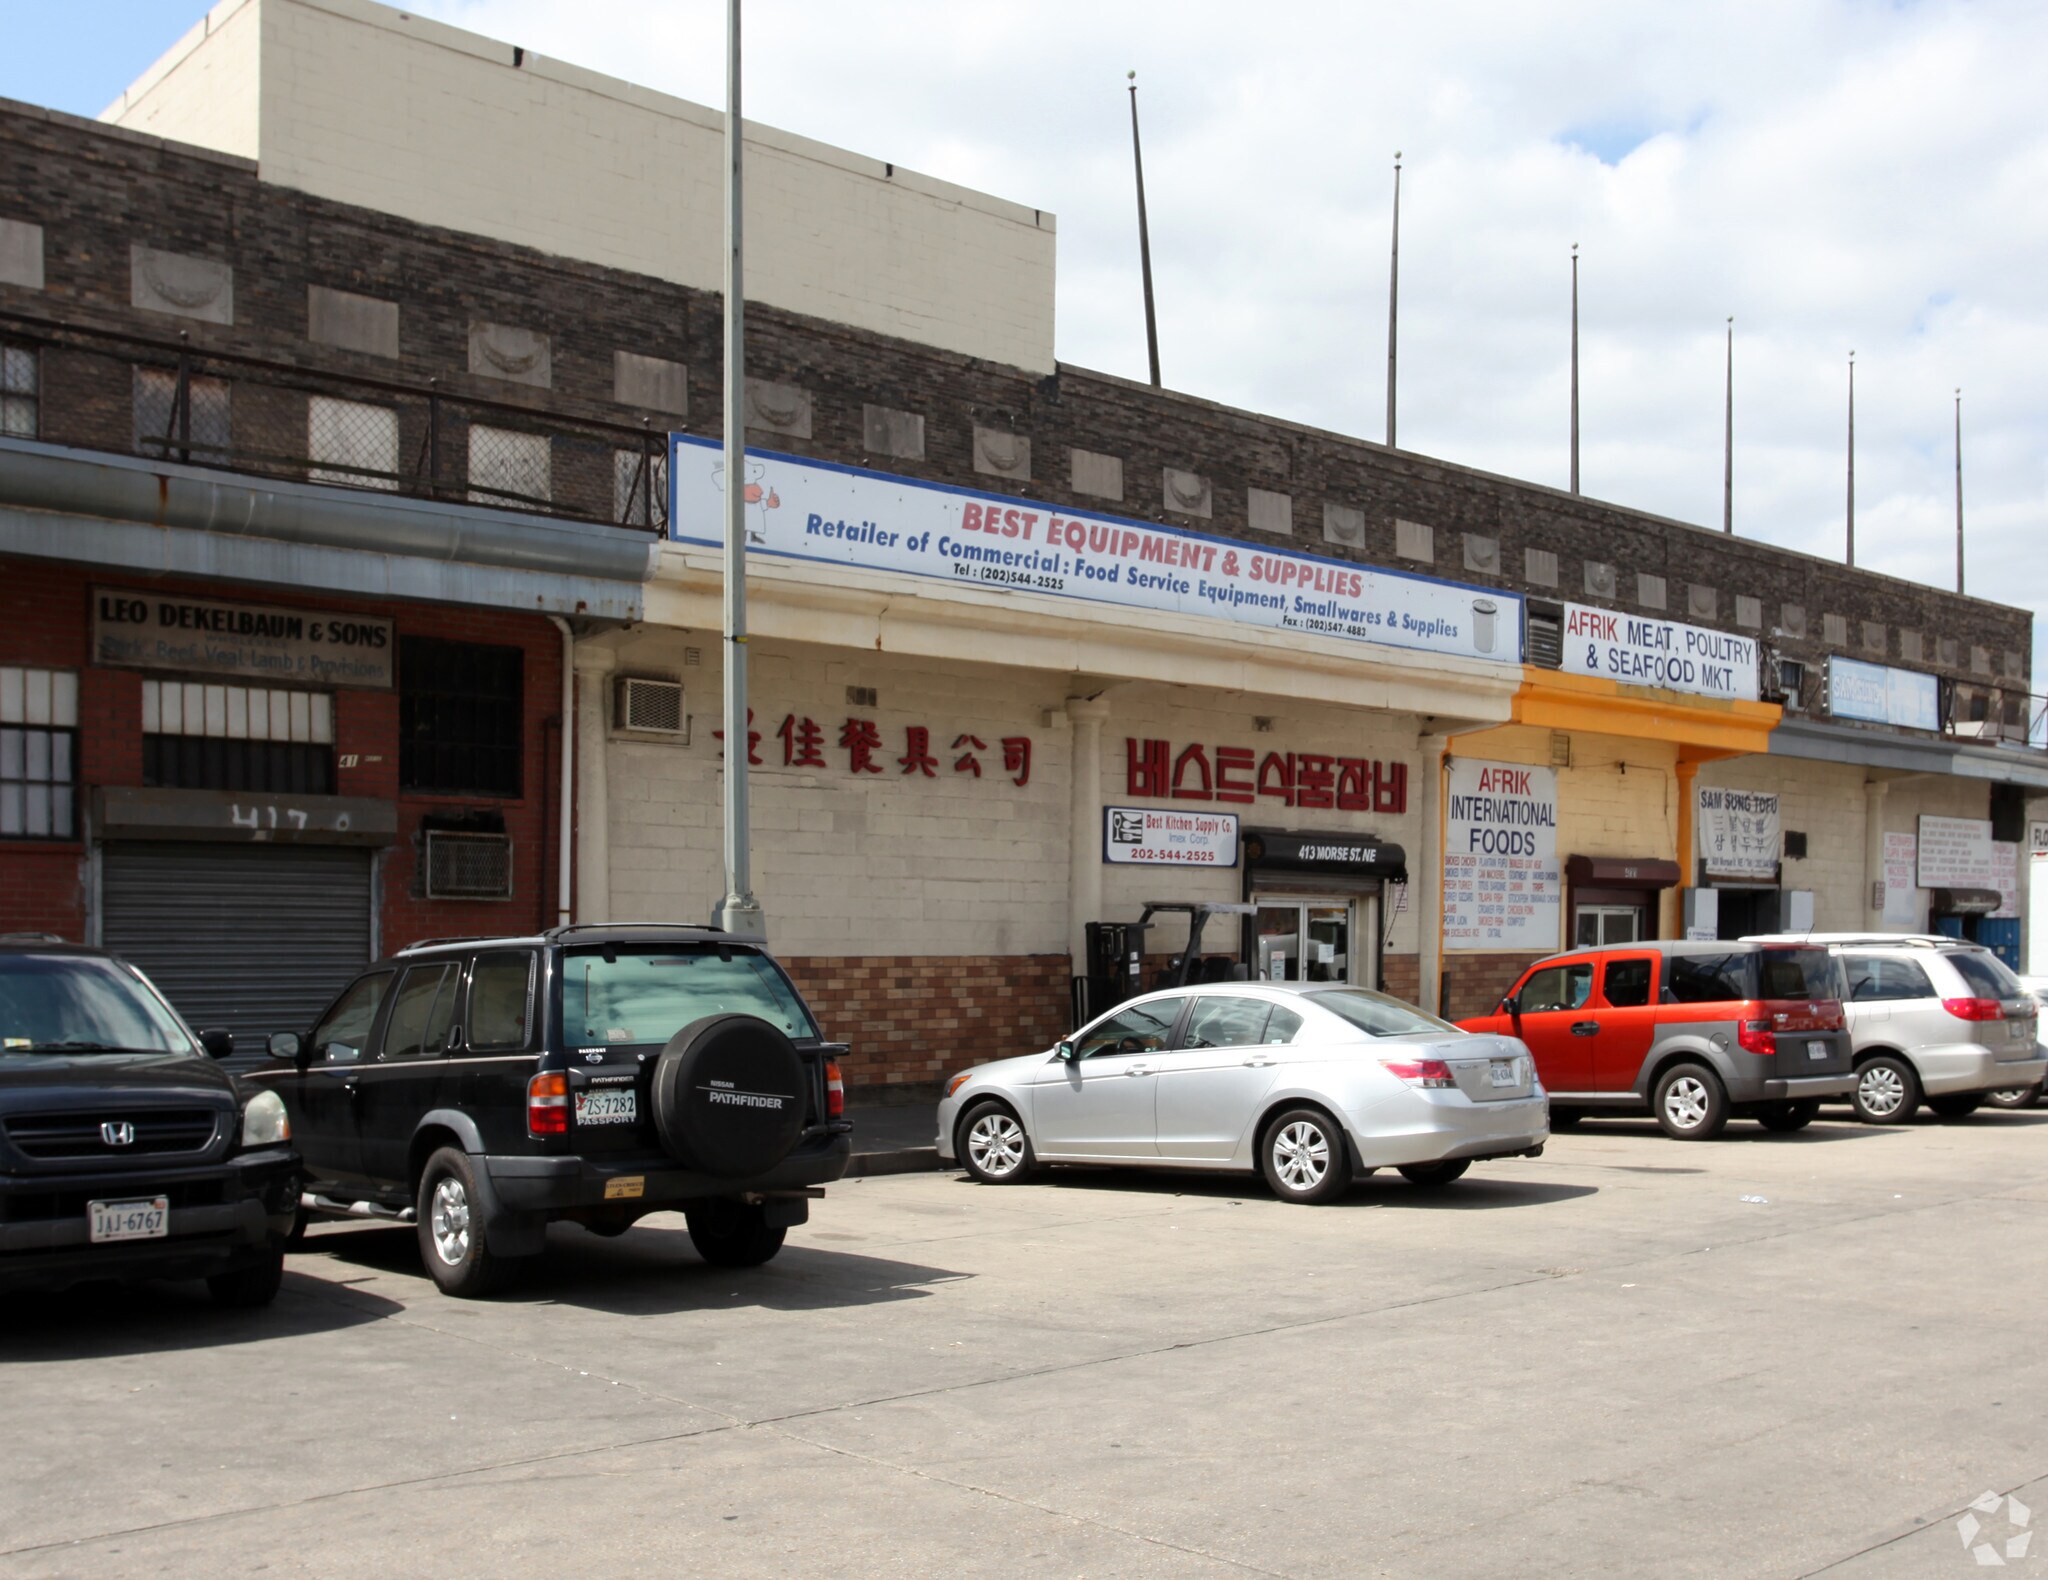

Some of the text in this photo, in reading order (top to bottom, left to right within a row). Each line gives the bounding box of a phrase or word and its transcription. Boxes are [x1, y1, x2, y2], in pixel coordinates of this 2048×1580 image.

[962, 501, 1363, 598] BEST EQUIPMENT & SUPPLIES
[806, 513, 900, 548] Retailer
[906, 531, 930, 553] of
[1074, 558, 1120, 583] Food
[1126, 566, 1190, 595] Service
[1198, 580, 1289, 613] Equipment,
[1293, 595, 1382, 626] Smallwares
[1386, 611, 1398, 628] &
[1402, 613, 1458, 639] Supplies
[980, 566, 1064, 591] (202)544-2525
[100, 597, 388, 648] LEO DEKELBAUM & SONS
[1305, 617, 1367, 638] (202)547-4883
[1567, 609, 1752, 666] AFRIK MEAT, POULTRY
[311, 654, 385, 679] Provisions
[1586, 643, 1737, 692] & SEAFOOD MKT.
[1126, 737, 1408, 814] 베스트식품장비
[1478, 767, 1531, 796] AFRIK
[1451, 794, 1556, 828] INTERNATIONAL
[1700, 790, 1778, 814] SAM SUNG TOFU
[1146, 814, 1232, 835] Best Kitchen Supply Co.
[1169, 833, 1186, 843] Imex
[1469, 827, 1535, 856] FOODS
[1131, 848, 1215, 861] 202-544-2525
[1298, 845, 1316, 860] 413
[1316, 846, 1348, 861] MORSE
[578, 1047, 607, 1055] PASSPORT
[591, 1075, 635, 1084] PATHFINDER
[710, 1080, 734, 1089] NISSAN
[709, 1091, 783, 1109] PATHFINDER
[577, 1115, 636, 1126] PASSPORT
